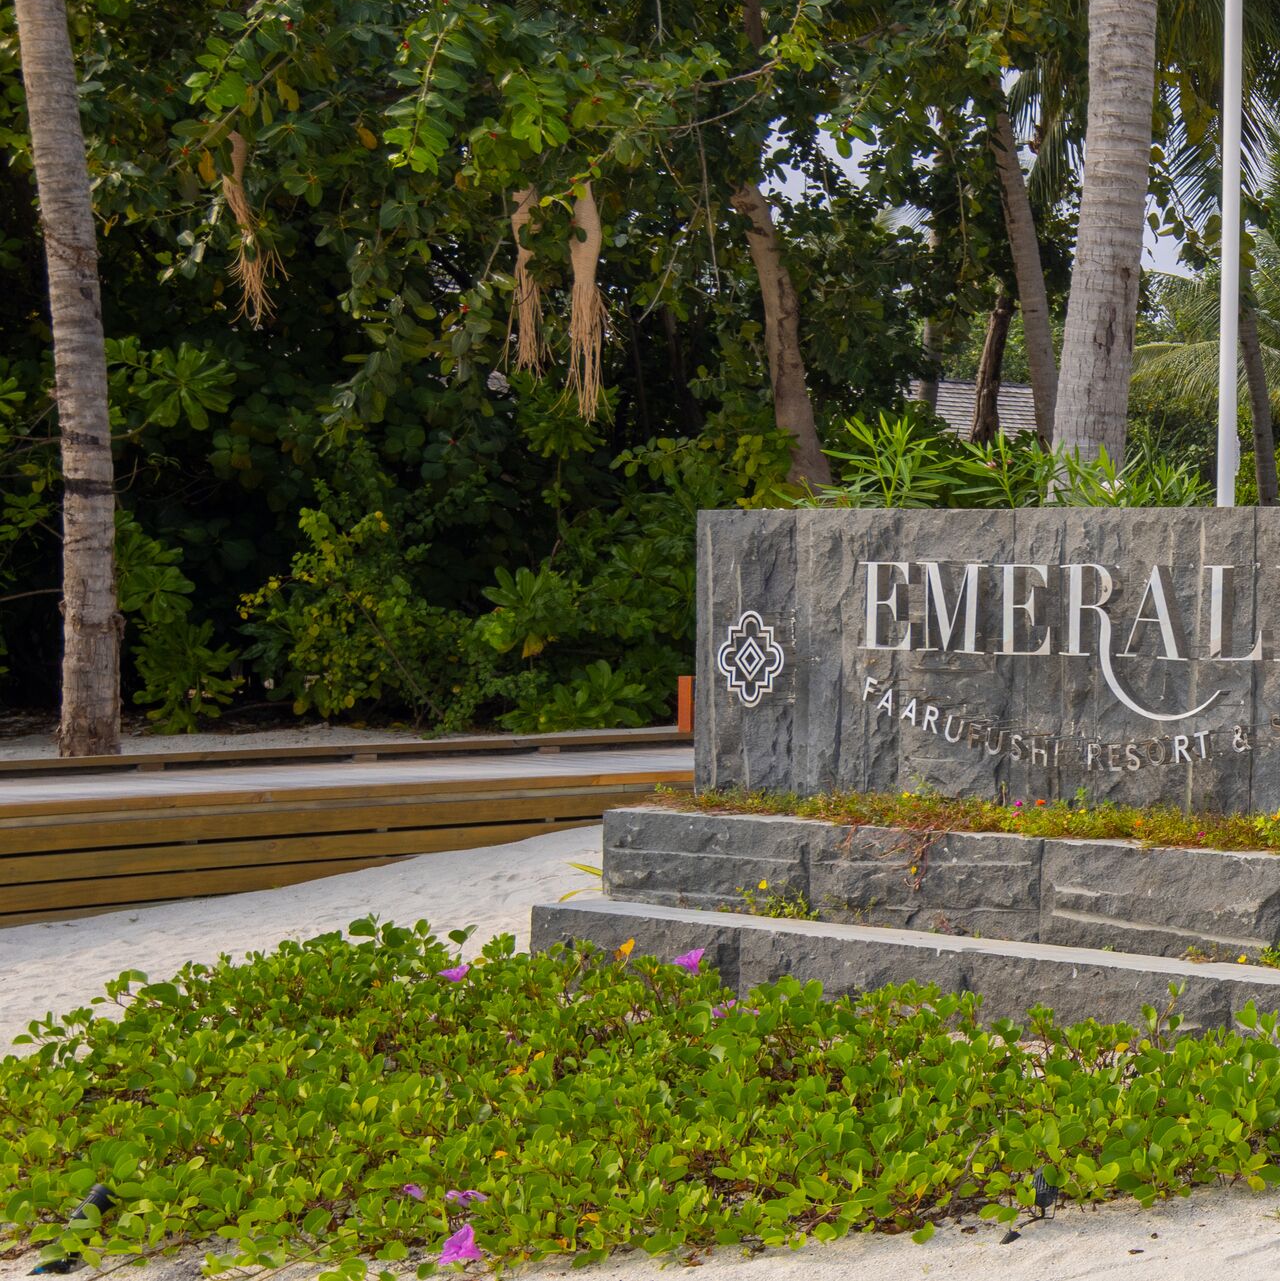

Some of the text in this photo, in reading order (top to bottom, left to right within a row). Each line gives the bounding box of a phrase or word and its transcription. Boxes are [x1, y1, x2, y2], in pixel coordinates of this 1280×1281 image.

[862, 676, 1060, 767] FAARUFUSHI
[1087, 730, 1209, 772] RESORT
[1232, 725, 1252, 753] &
